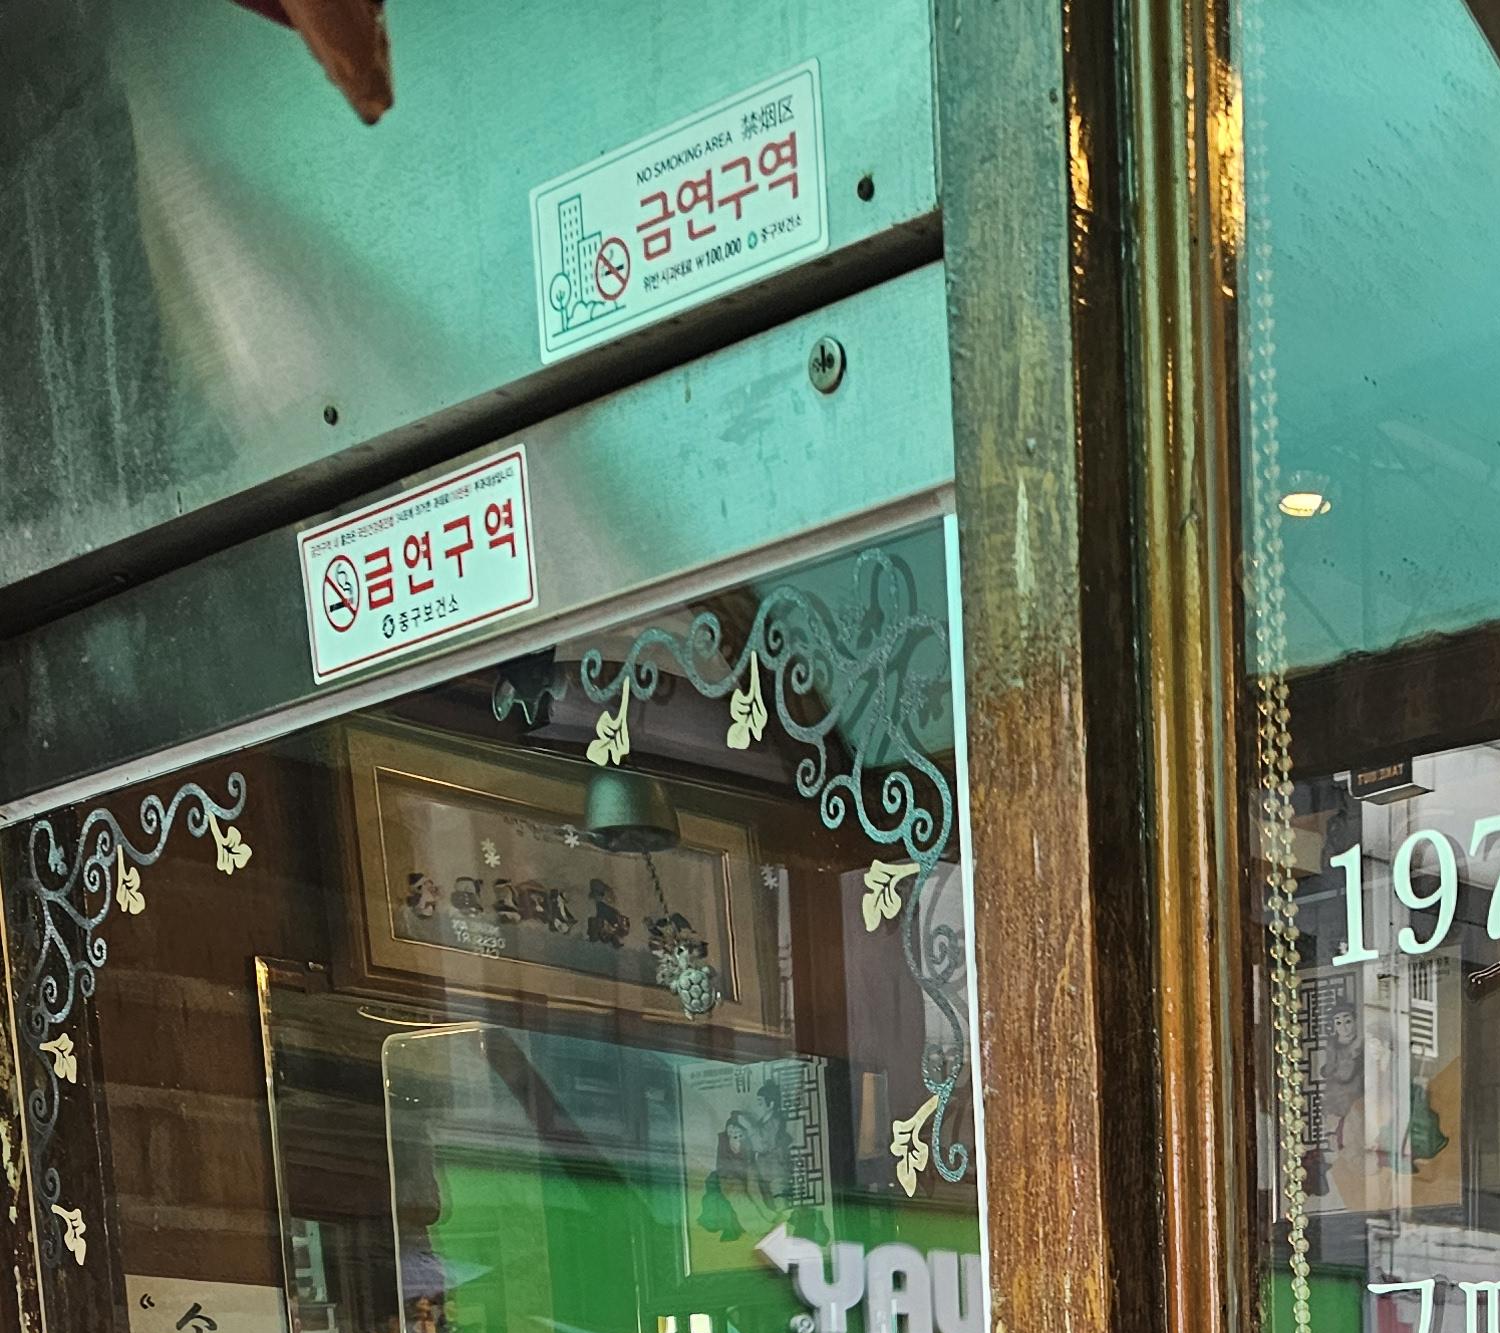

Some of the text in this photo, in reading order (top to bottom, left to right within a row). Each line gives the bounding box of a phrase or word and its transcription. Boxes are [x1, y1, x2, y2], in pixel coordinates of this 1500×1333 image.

[636, 131, 733, 185] NO SMOKING AREA
[636, 131, 798, 261] 금연구역
[364, 498, 517, 611] 금연구역
[399, 593, 460, 632] 중구보건소
